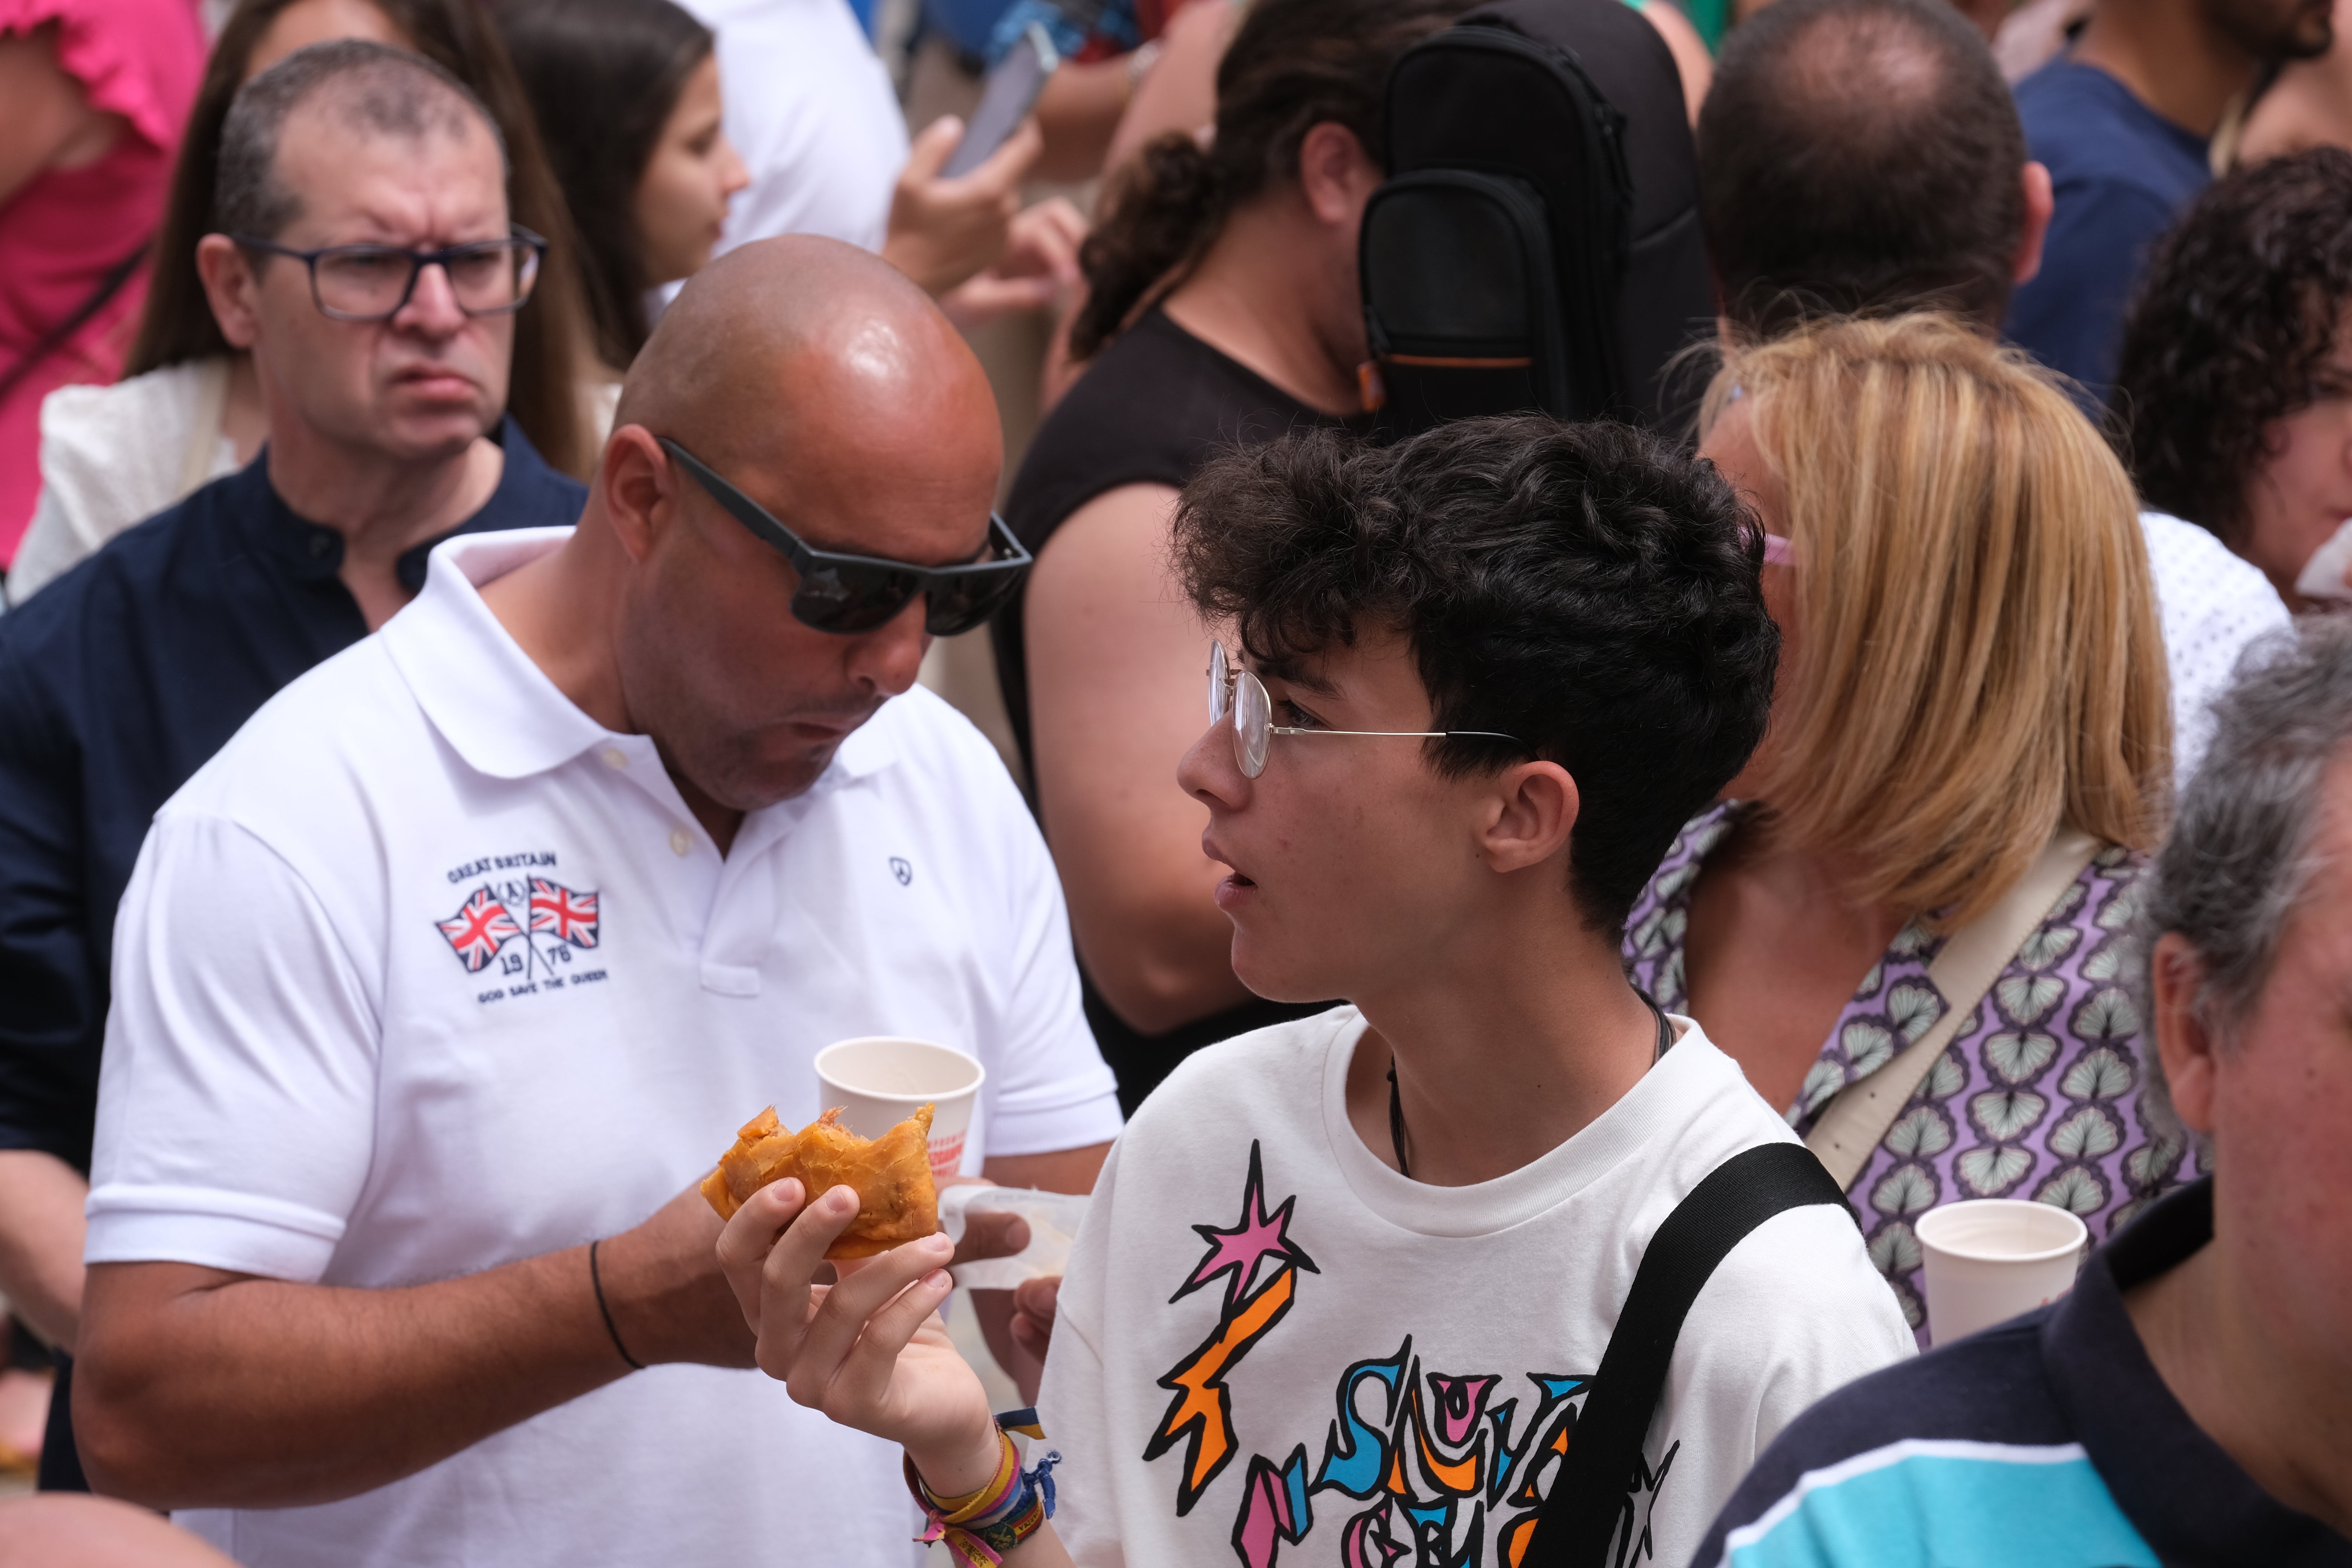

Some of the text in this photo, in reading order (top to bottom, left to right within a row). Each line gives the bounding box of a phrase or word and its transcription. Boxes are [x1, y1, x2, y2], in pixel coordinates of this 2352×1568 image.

[448, 852, 557, 883] GREAT BRITAIN
[501, 953, 524, 975] 19
[478, 969, 608, 1003] GOD SAVE THE QUEEN
